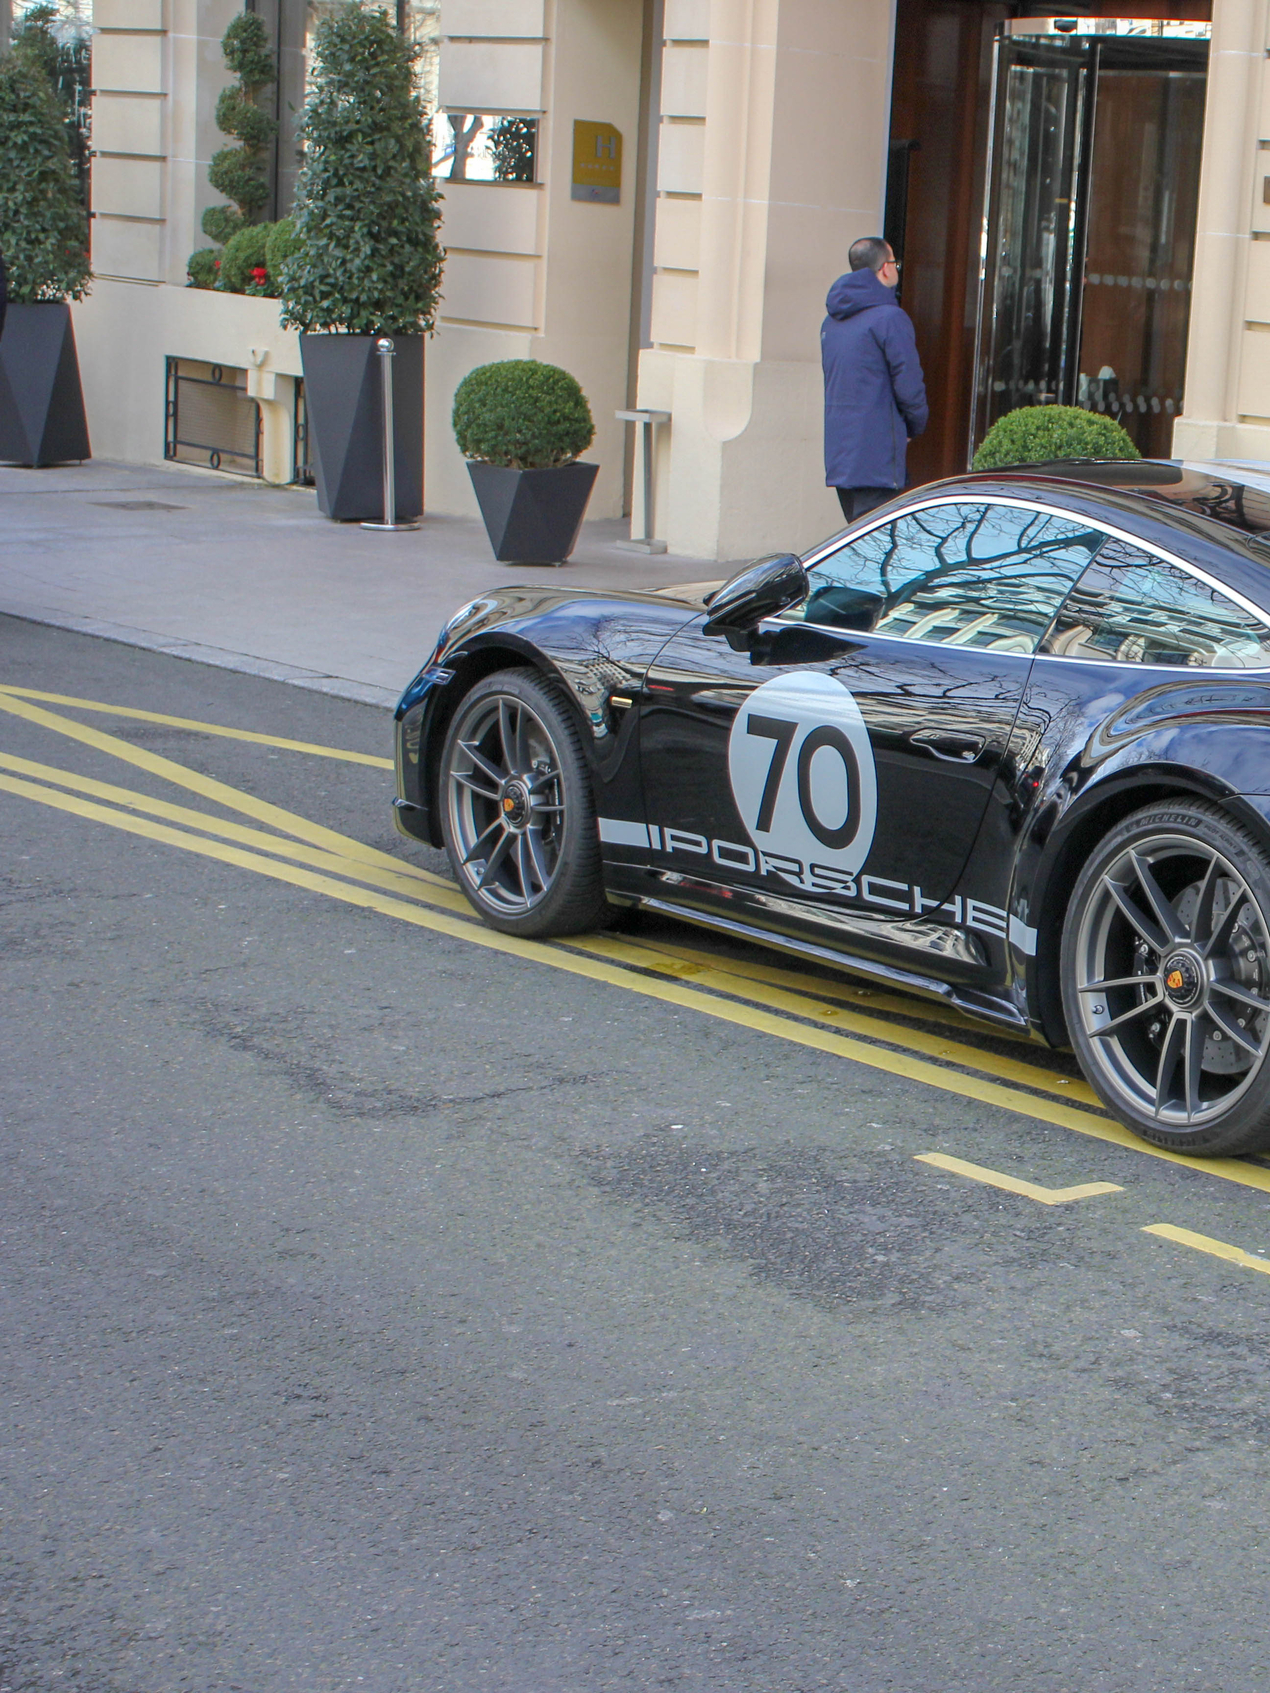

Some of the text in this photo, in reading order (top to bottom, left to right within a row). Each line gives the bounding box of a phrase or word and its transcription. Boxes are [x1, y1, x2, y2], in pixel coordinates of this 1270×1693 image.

[596, 135, 616, 159] H
[746, 713, 861, 850] 70
[1139, 814, 1199, 827] MICHELIN
[665, 826, 1008, 940] PORSCHE
